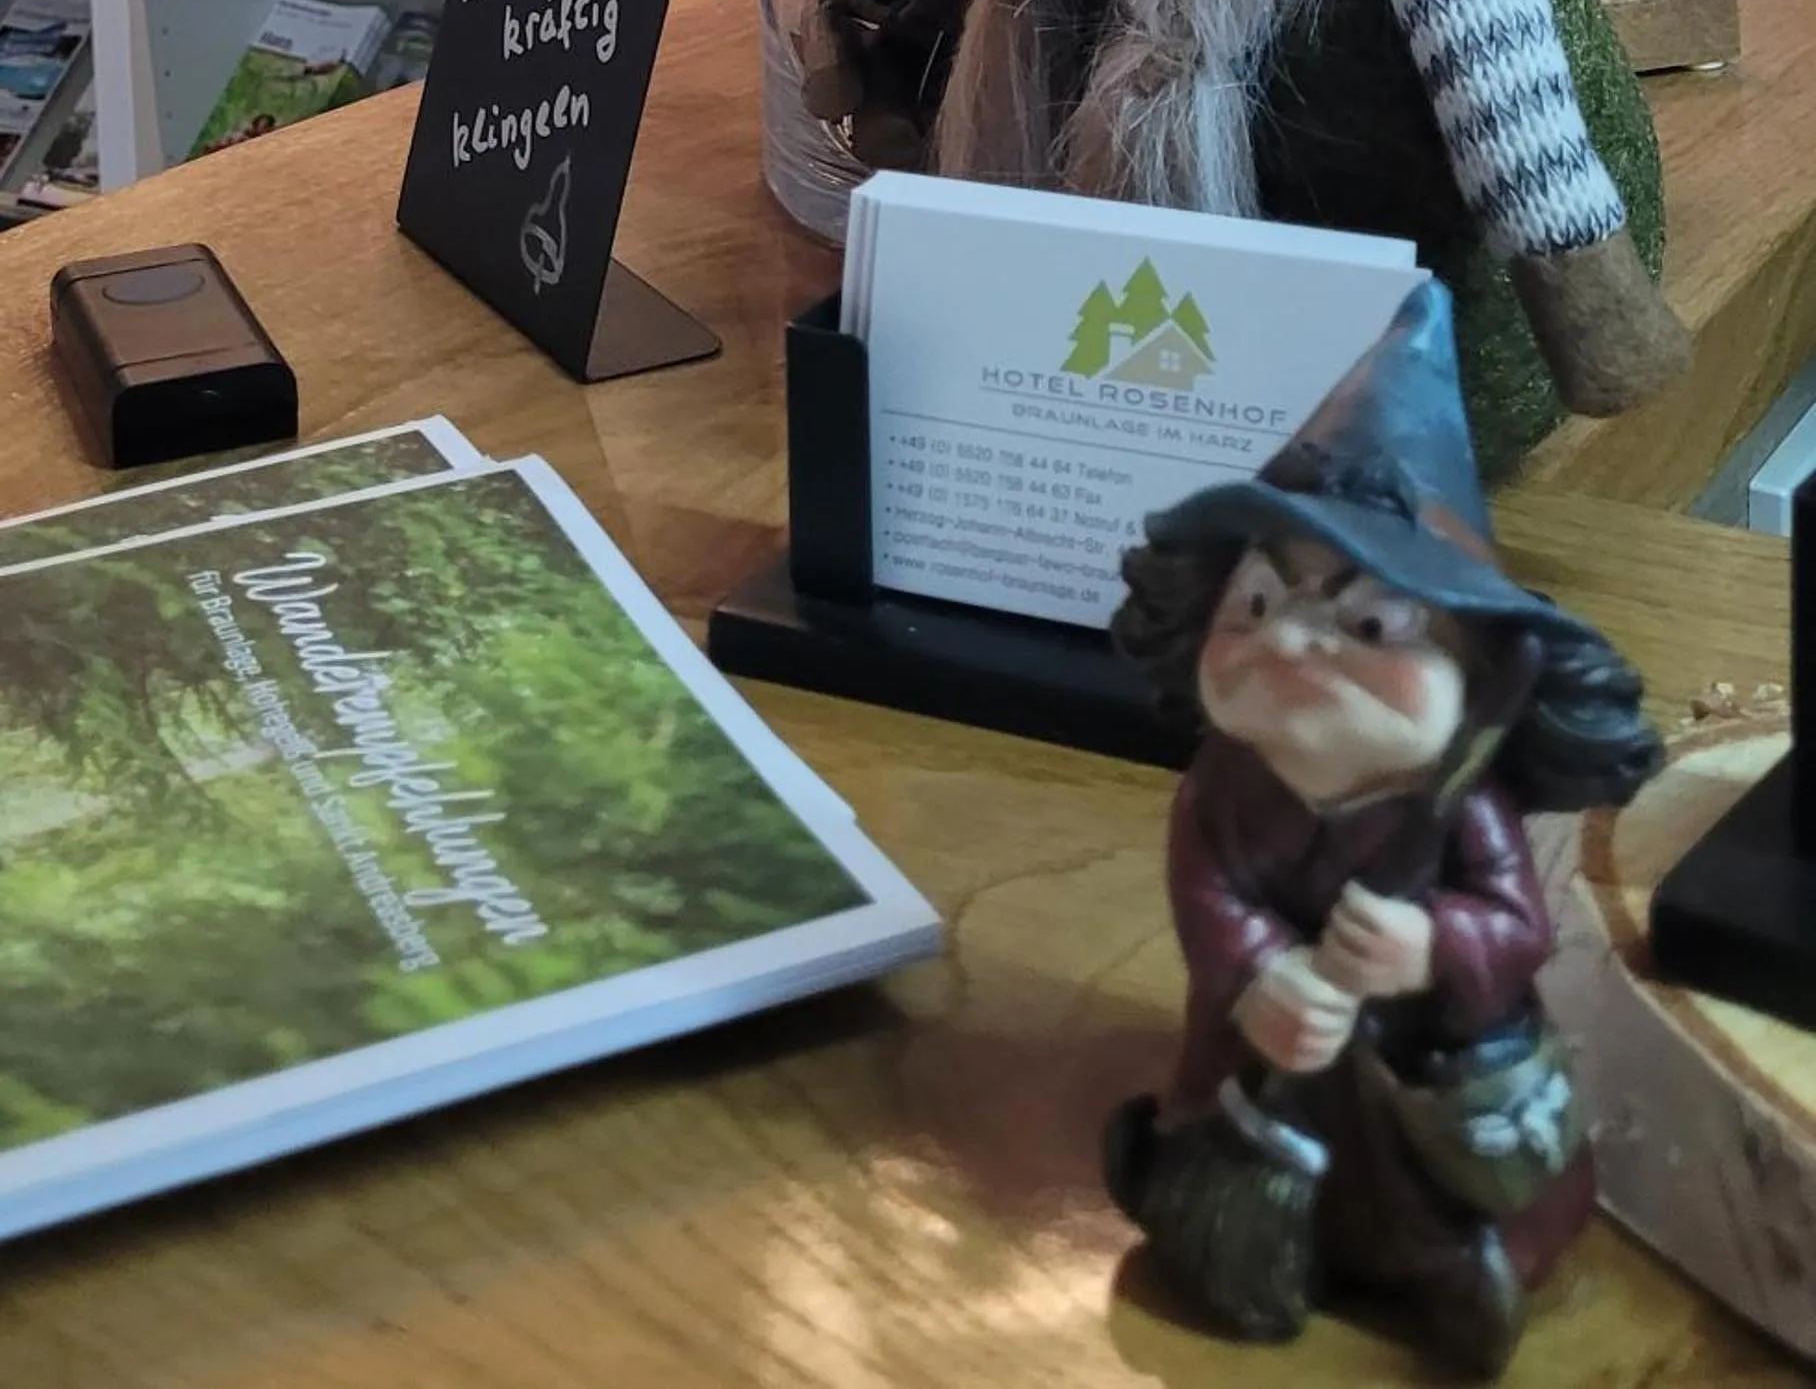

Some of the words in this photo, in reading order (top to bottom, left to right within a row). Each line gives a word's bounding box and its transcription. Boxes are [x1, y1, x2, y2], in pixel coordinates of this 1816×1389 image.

[982, 365, 1085, 399] HOTEL
[1098, 382, 1288, 428] ROSENHOF
[1011, 402, 1149, 438] BRAUNLAGE
[1157, 424, 1183, 444] IM
[1189, 431, 1255, 455] HARZ
[233, 551, 548, 945] Wanderempfehlungen
